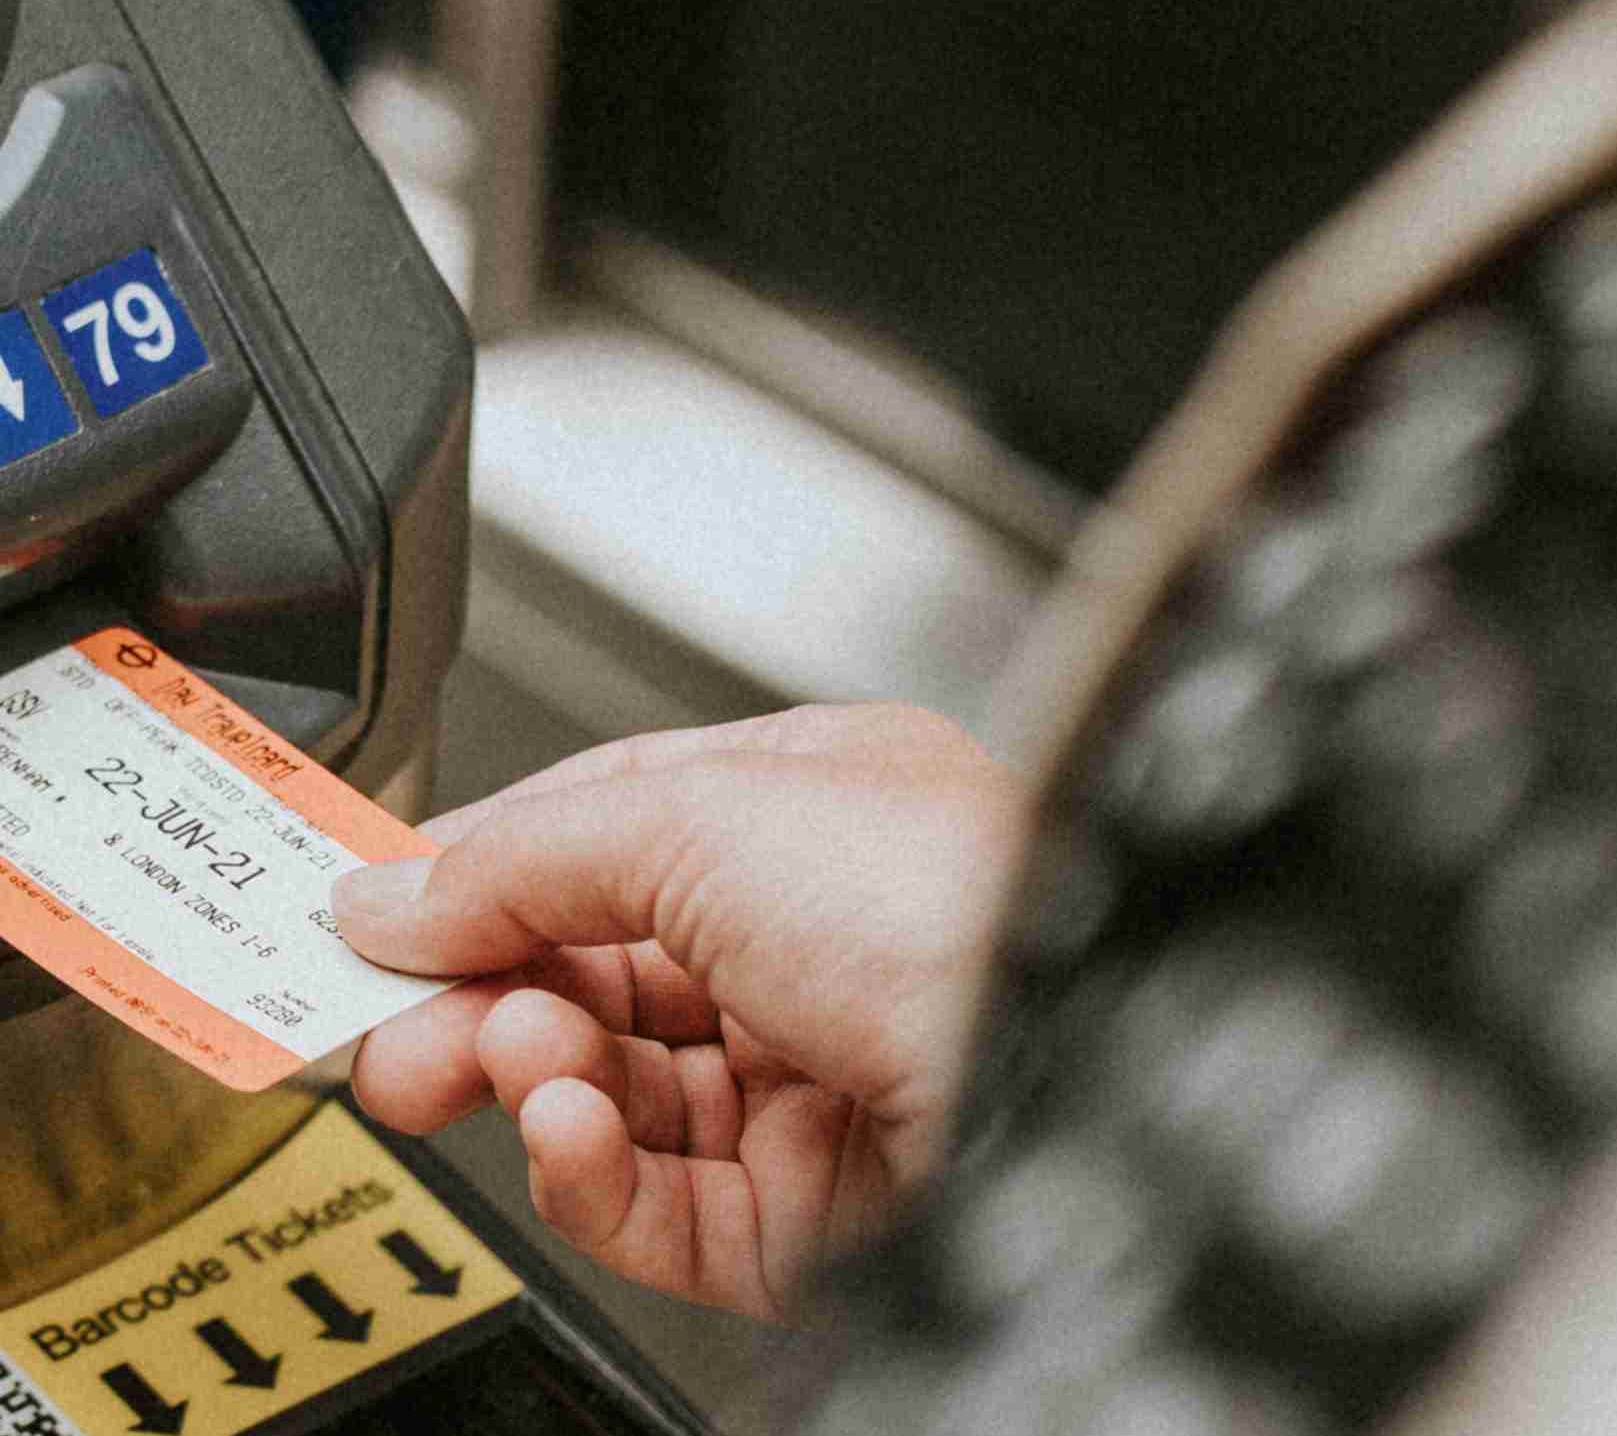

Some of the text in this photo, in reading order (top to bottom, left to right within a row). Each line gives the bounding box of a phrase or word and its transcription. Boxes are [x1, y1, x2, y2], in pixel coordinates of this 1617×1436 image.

[62, 282, 177, 387] 79
[83, 756, 267, 891] 22-JUN-21
[103, 833, 278, 959] & LONDON ZONES 1-6
[28, 1178, 397, 1364] Barcode Tickets
